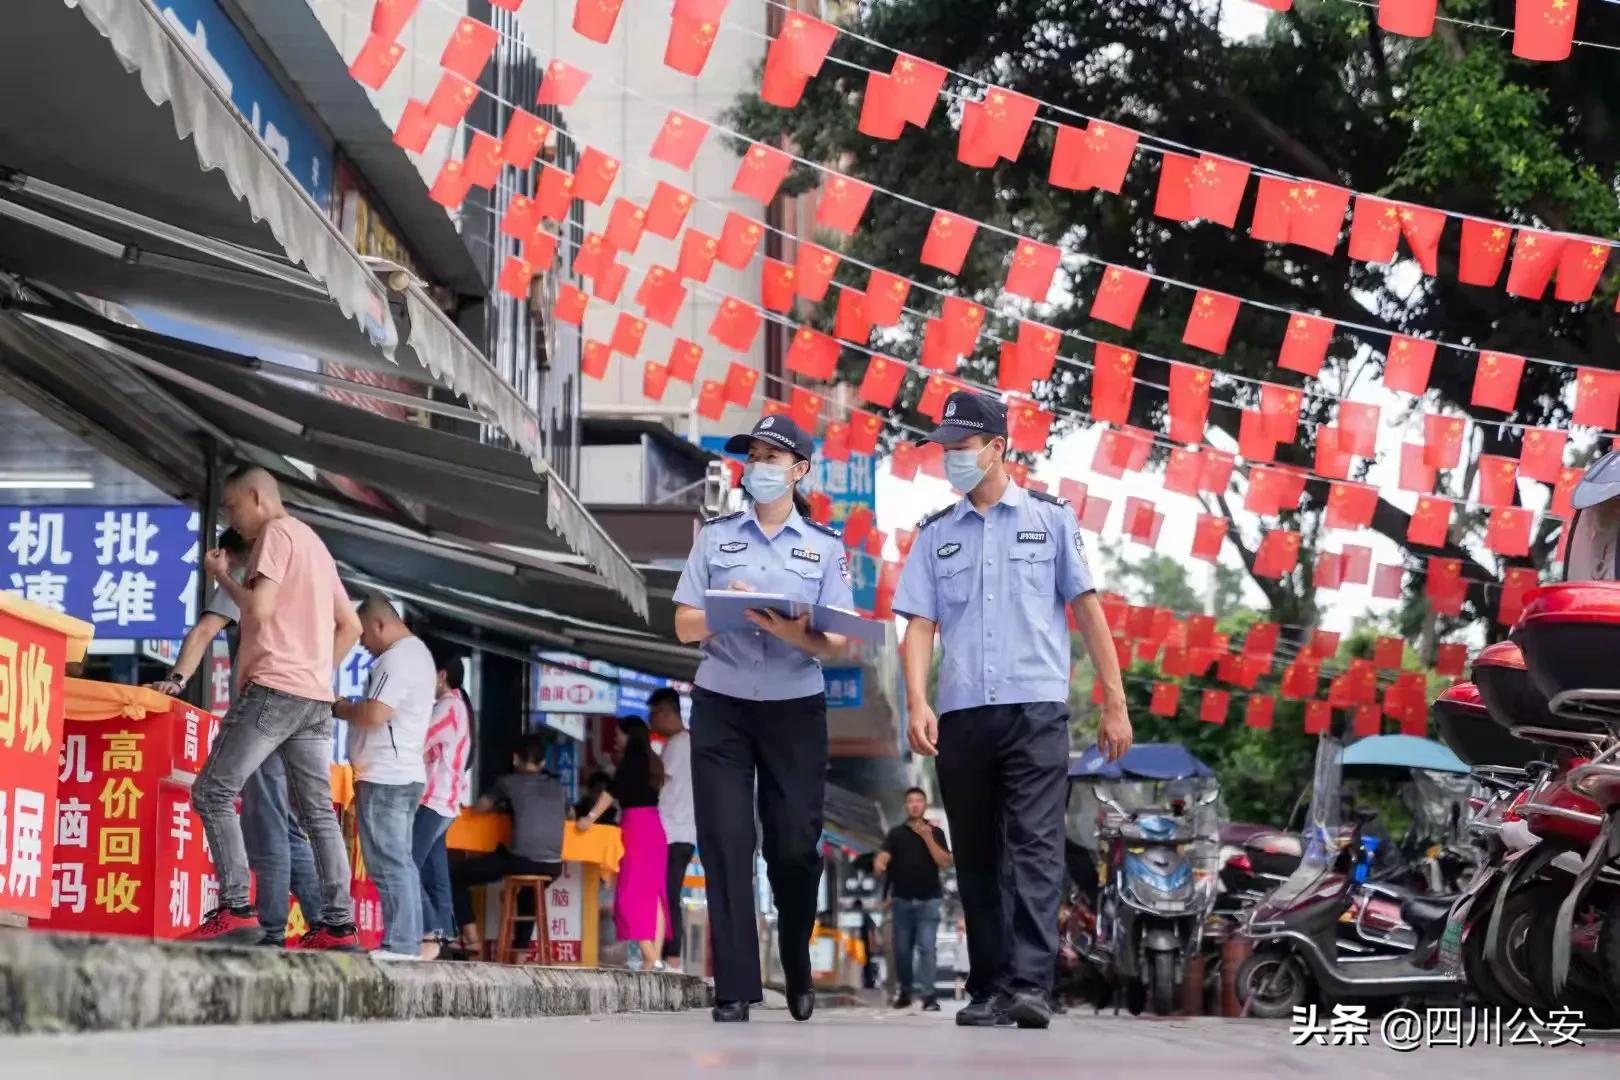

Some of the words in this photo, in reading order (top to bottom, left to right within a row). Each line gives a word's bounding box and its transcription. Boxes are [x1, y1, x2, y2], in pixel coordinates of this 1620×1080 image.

[0, 787, 45, 897] 屏
[95, 730, 145, 913] 高价回收
[169, 802, 192, 927] 手机
